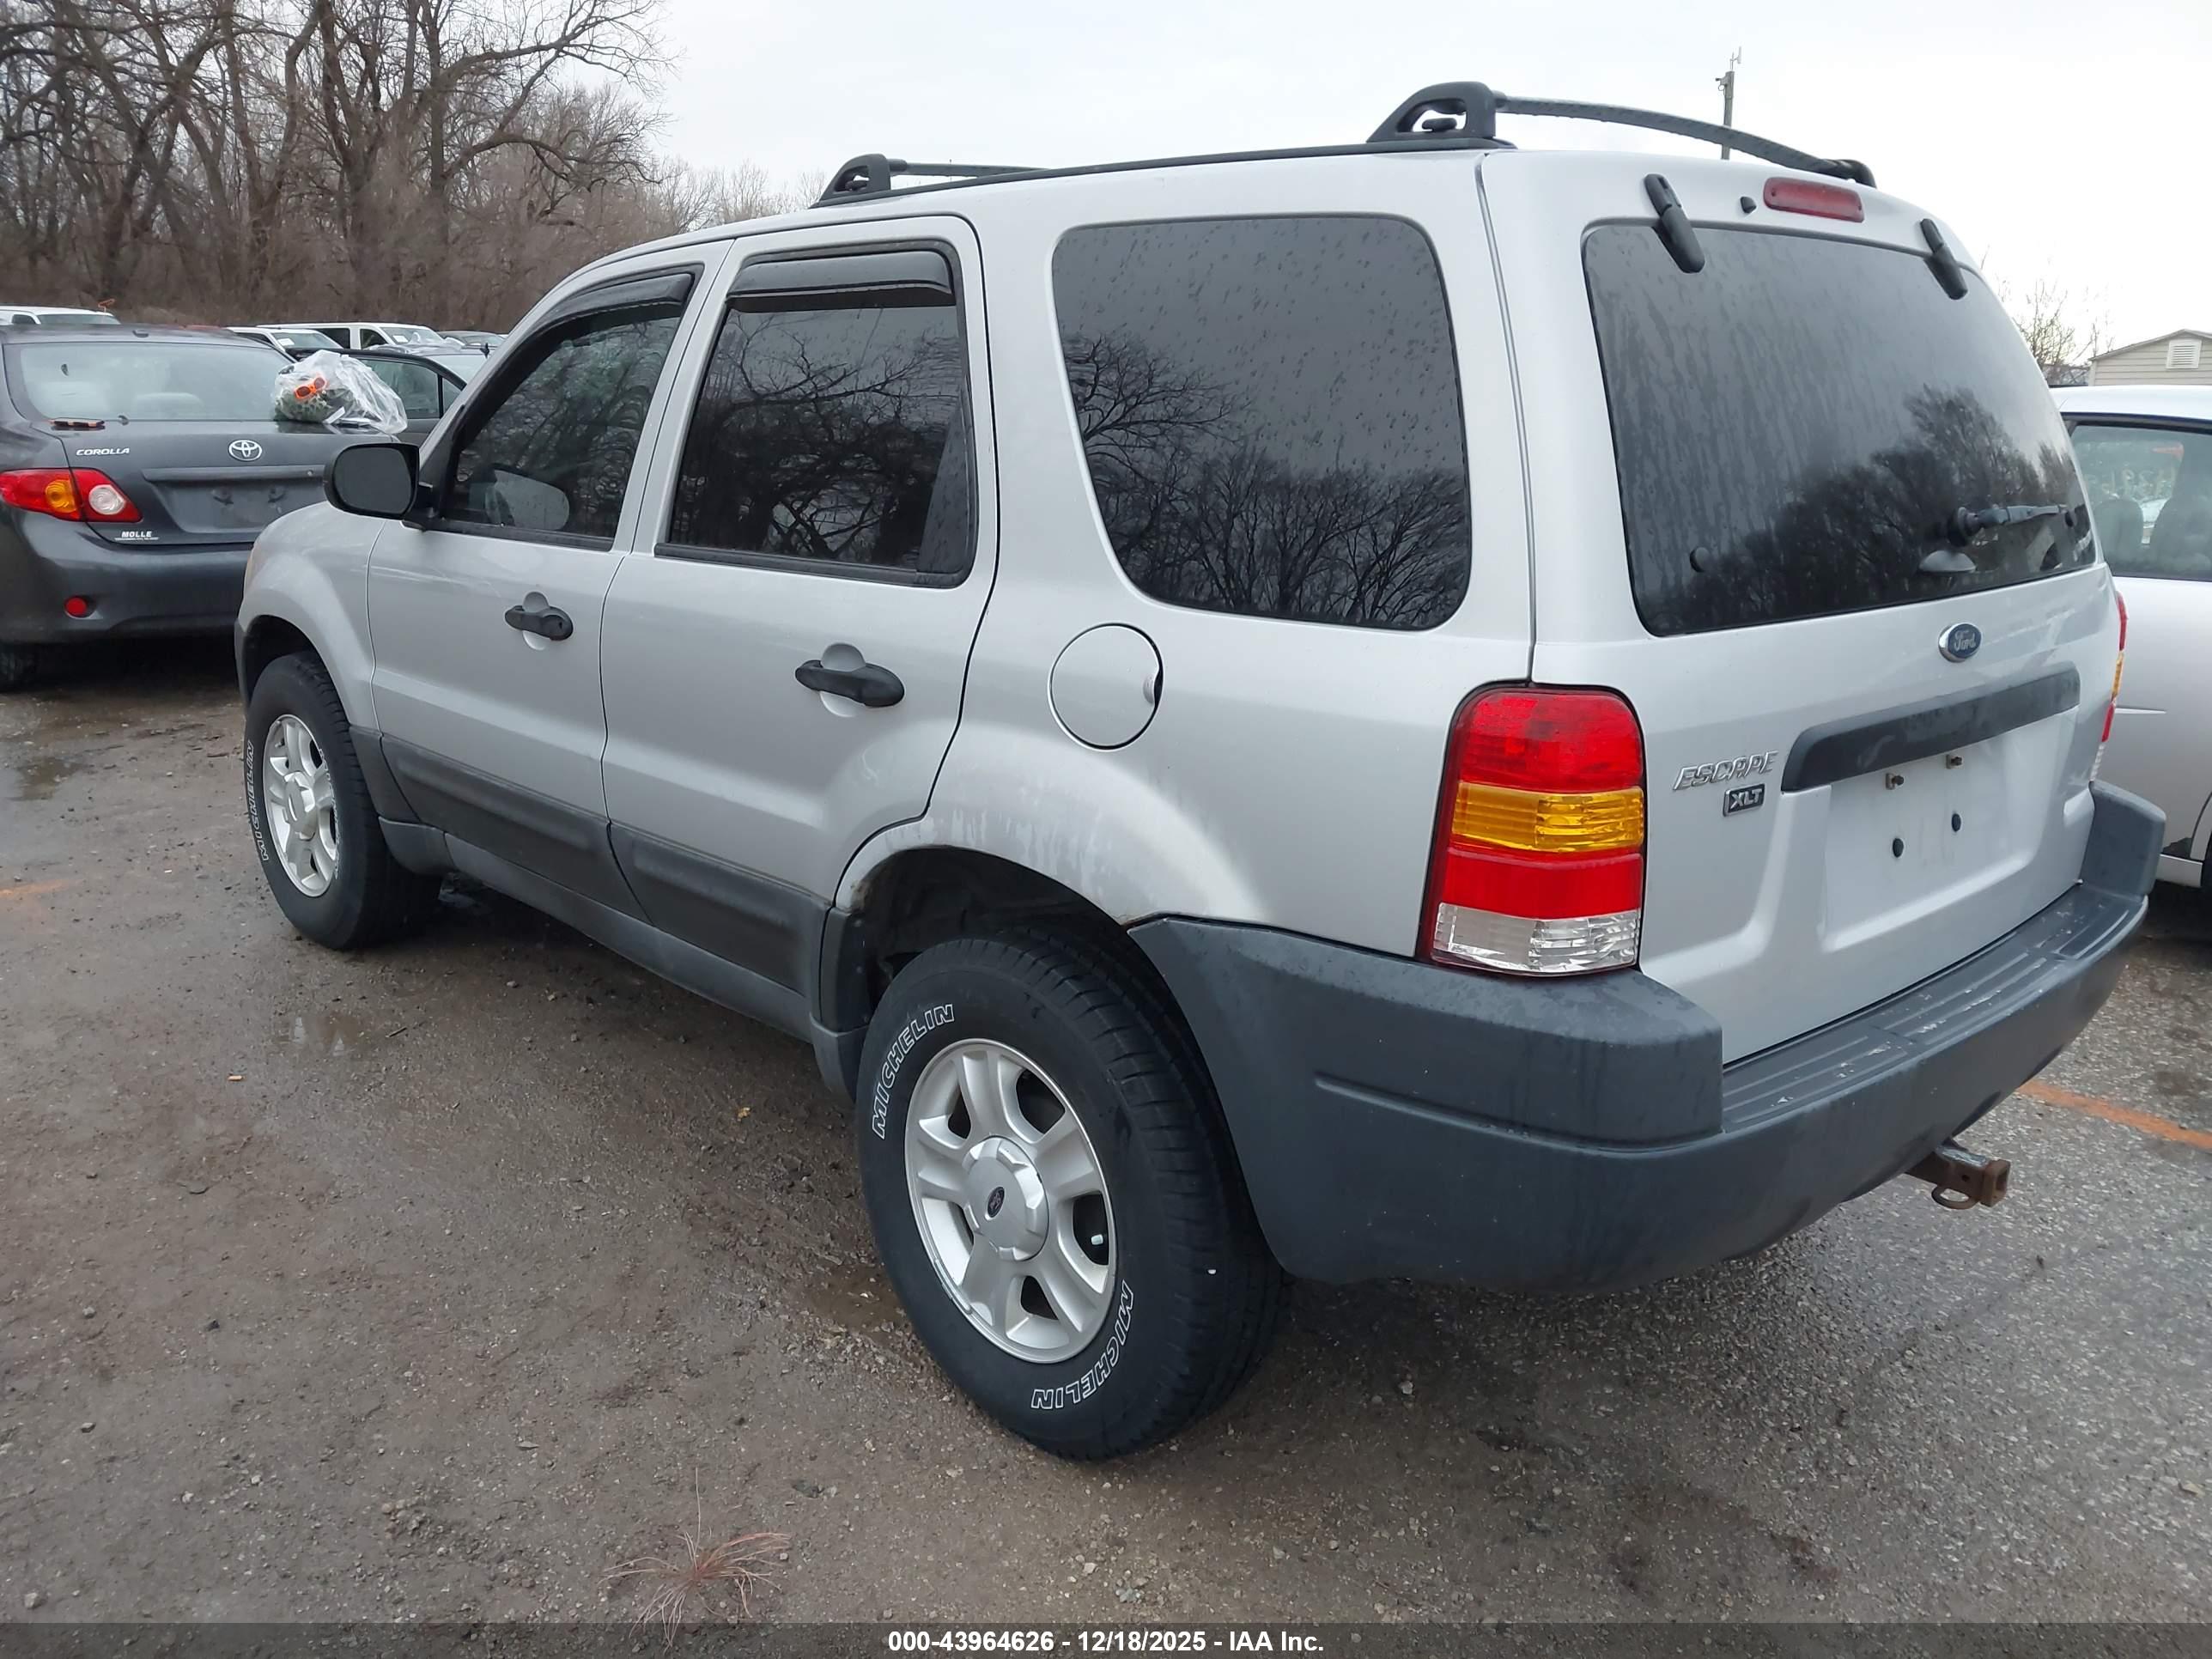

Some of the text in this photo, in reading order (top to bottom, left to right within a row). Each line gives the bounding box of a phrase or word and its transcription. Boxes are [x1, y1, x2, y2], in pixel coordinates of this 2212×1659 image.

[76, 447, 131, 456] COROLLA
[1954, 629, 1977, 652] Ford
[1673, 750, 1779, 791] ESCAPE
[246, 739, 269, 861] MICHELIN
[1729, 788, 1763, 810] XLT
[871, 1003, 955, 1140] MICHELIN
[1030, 1279, 1135, 1410] MICHELIN
